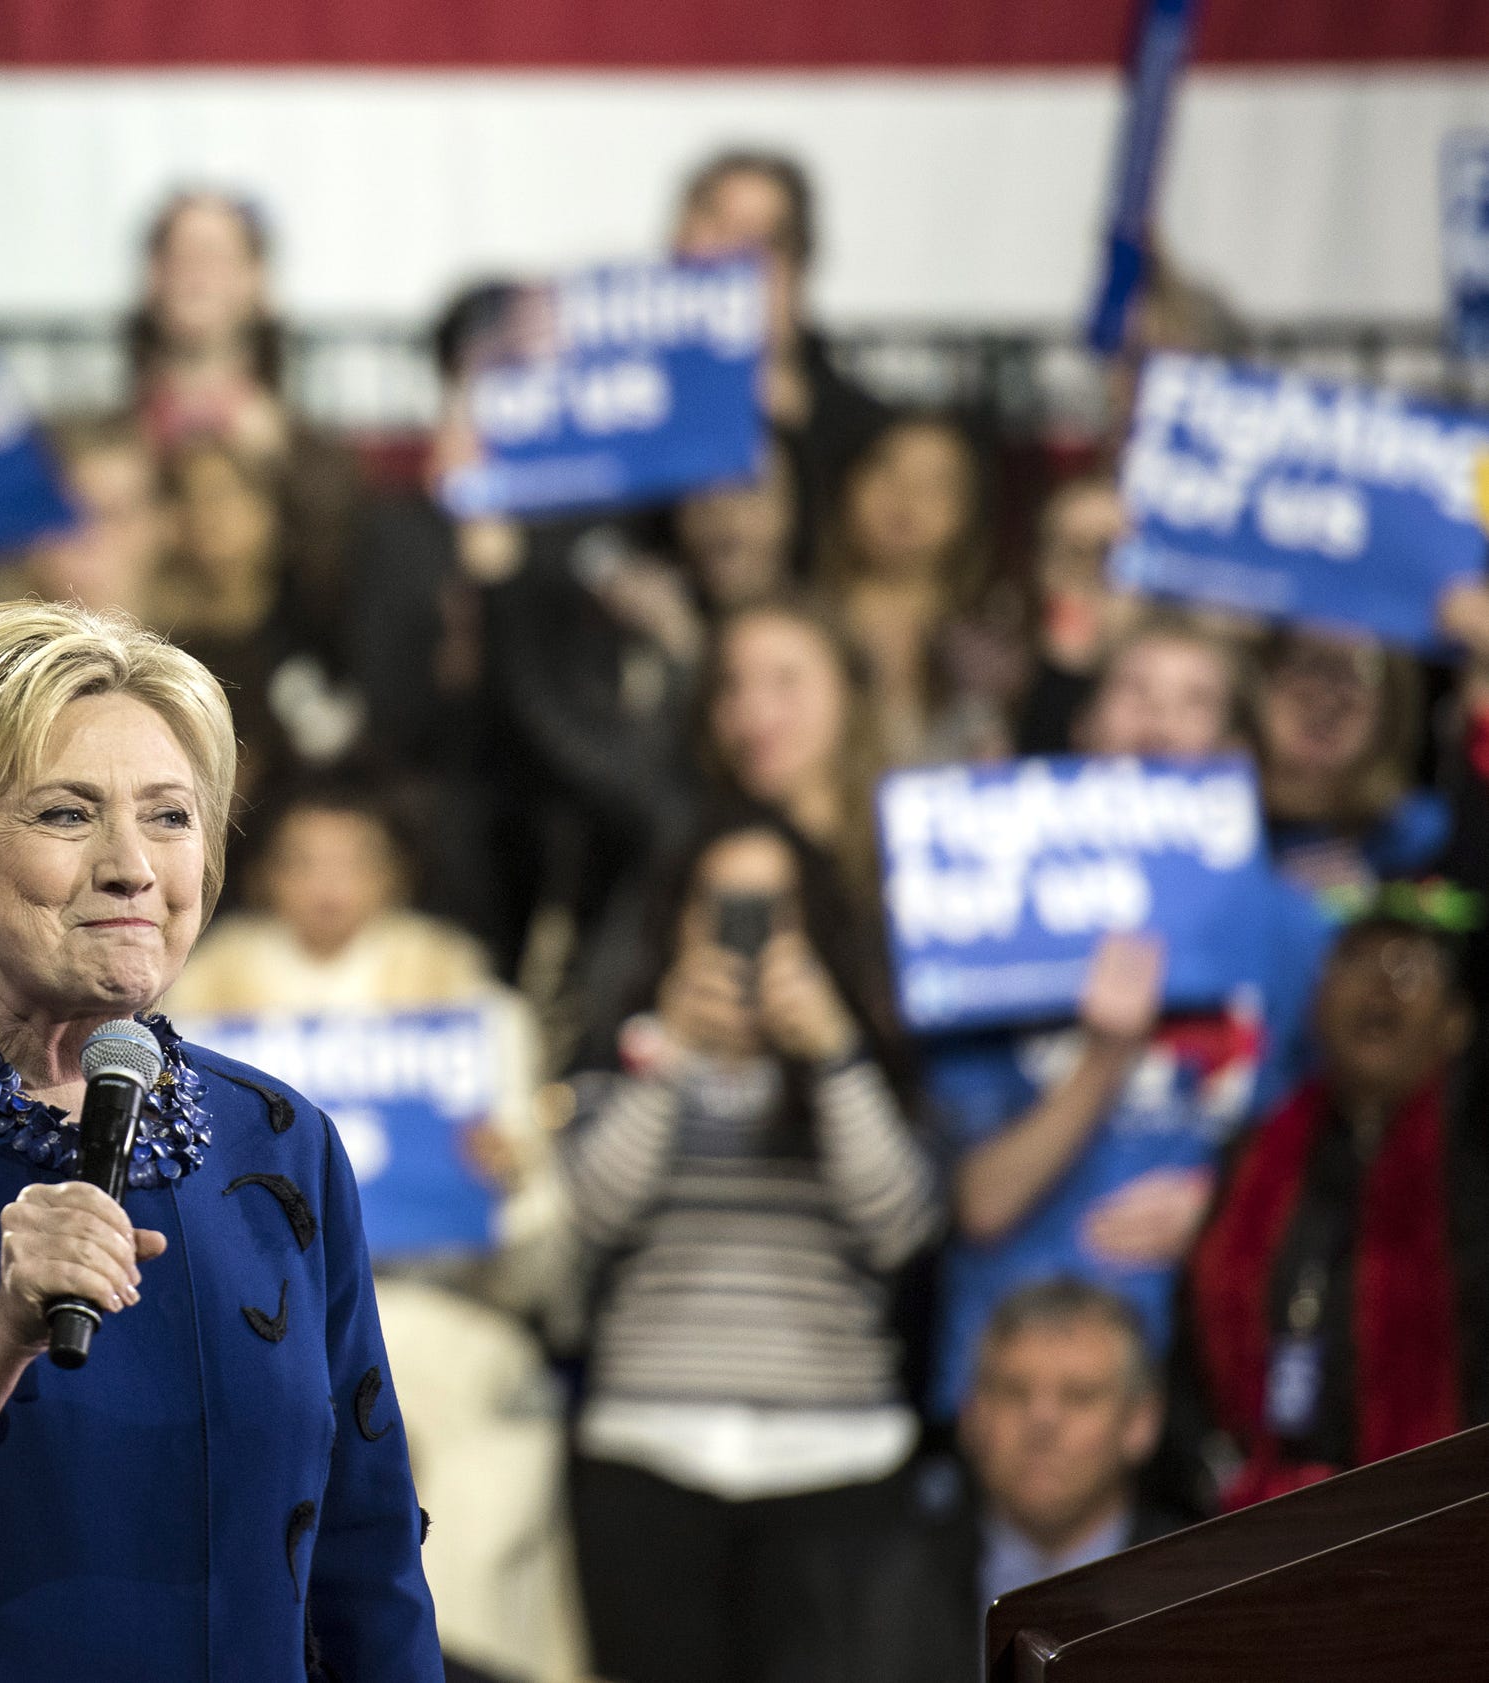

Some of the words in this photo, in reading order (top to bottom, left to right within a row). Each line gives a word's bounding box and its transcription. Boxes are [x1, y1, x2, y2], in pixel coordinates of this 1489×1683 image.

[1256, 484, 1368, 558] us
[881, 759, 1258, 869] Fighting
[890, 850, 1022, 947] for
[1036, 860, 1151, 935] us
